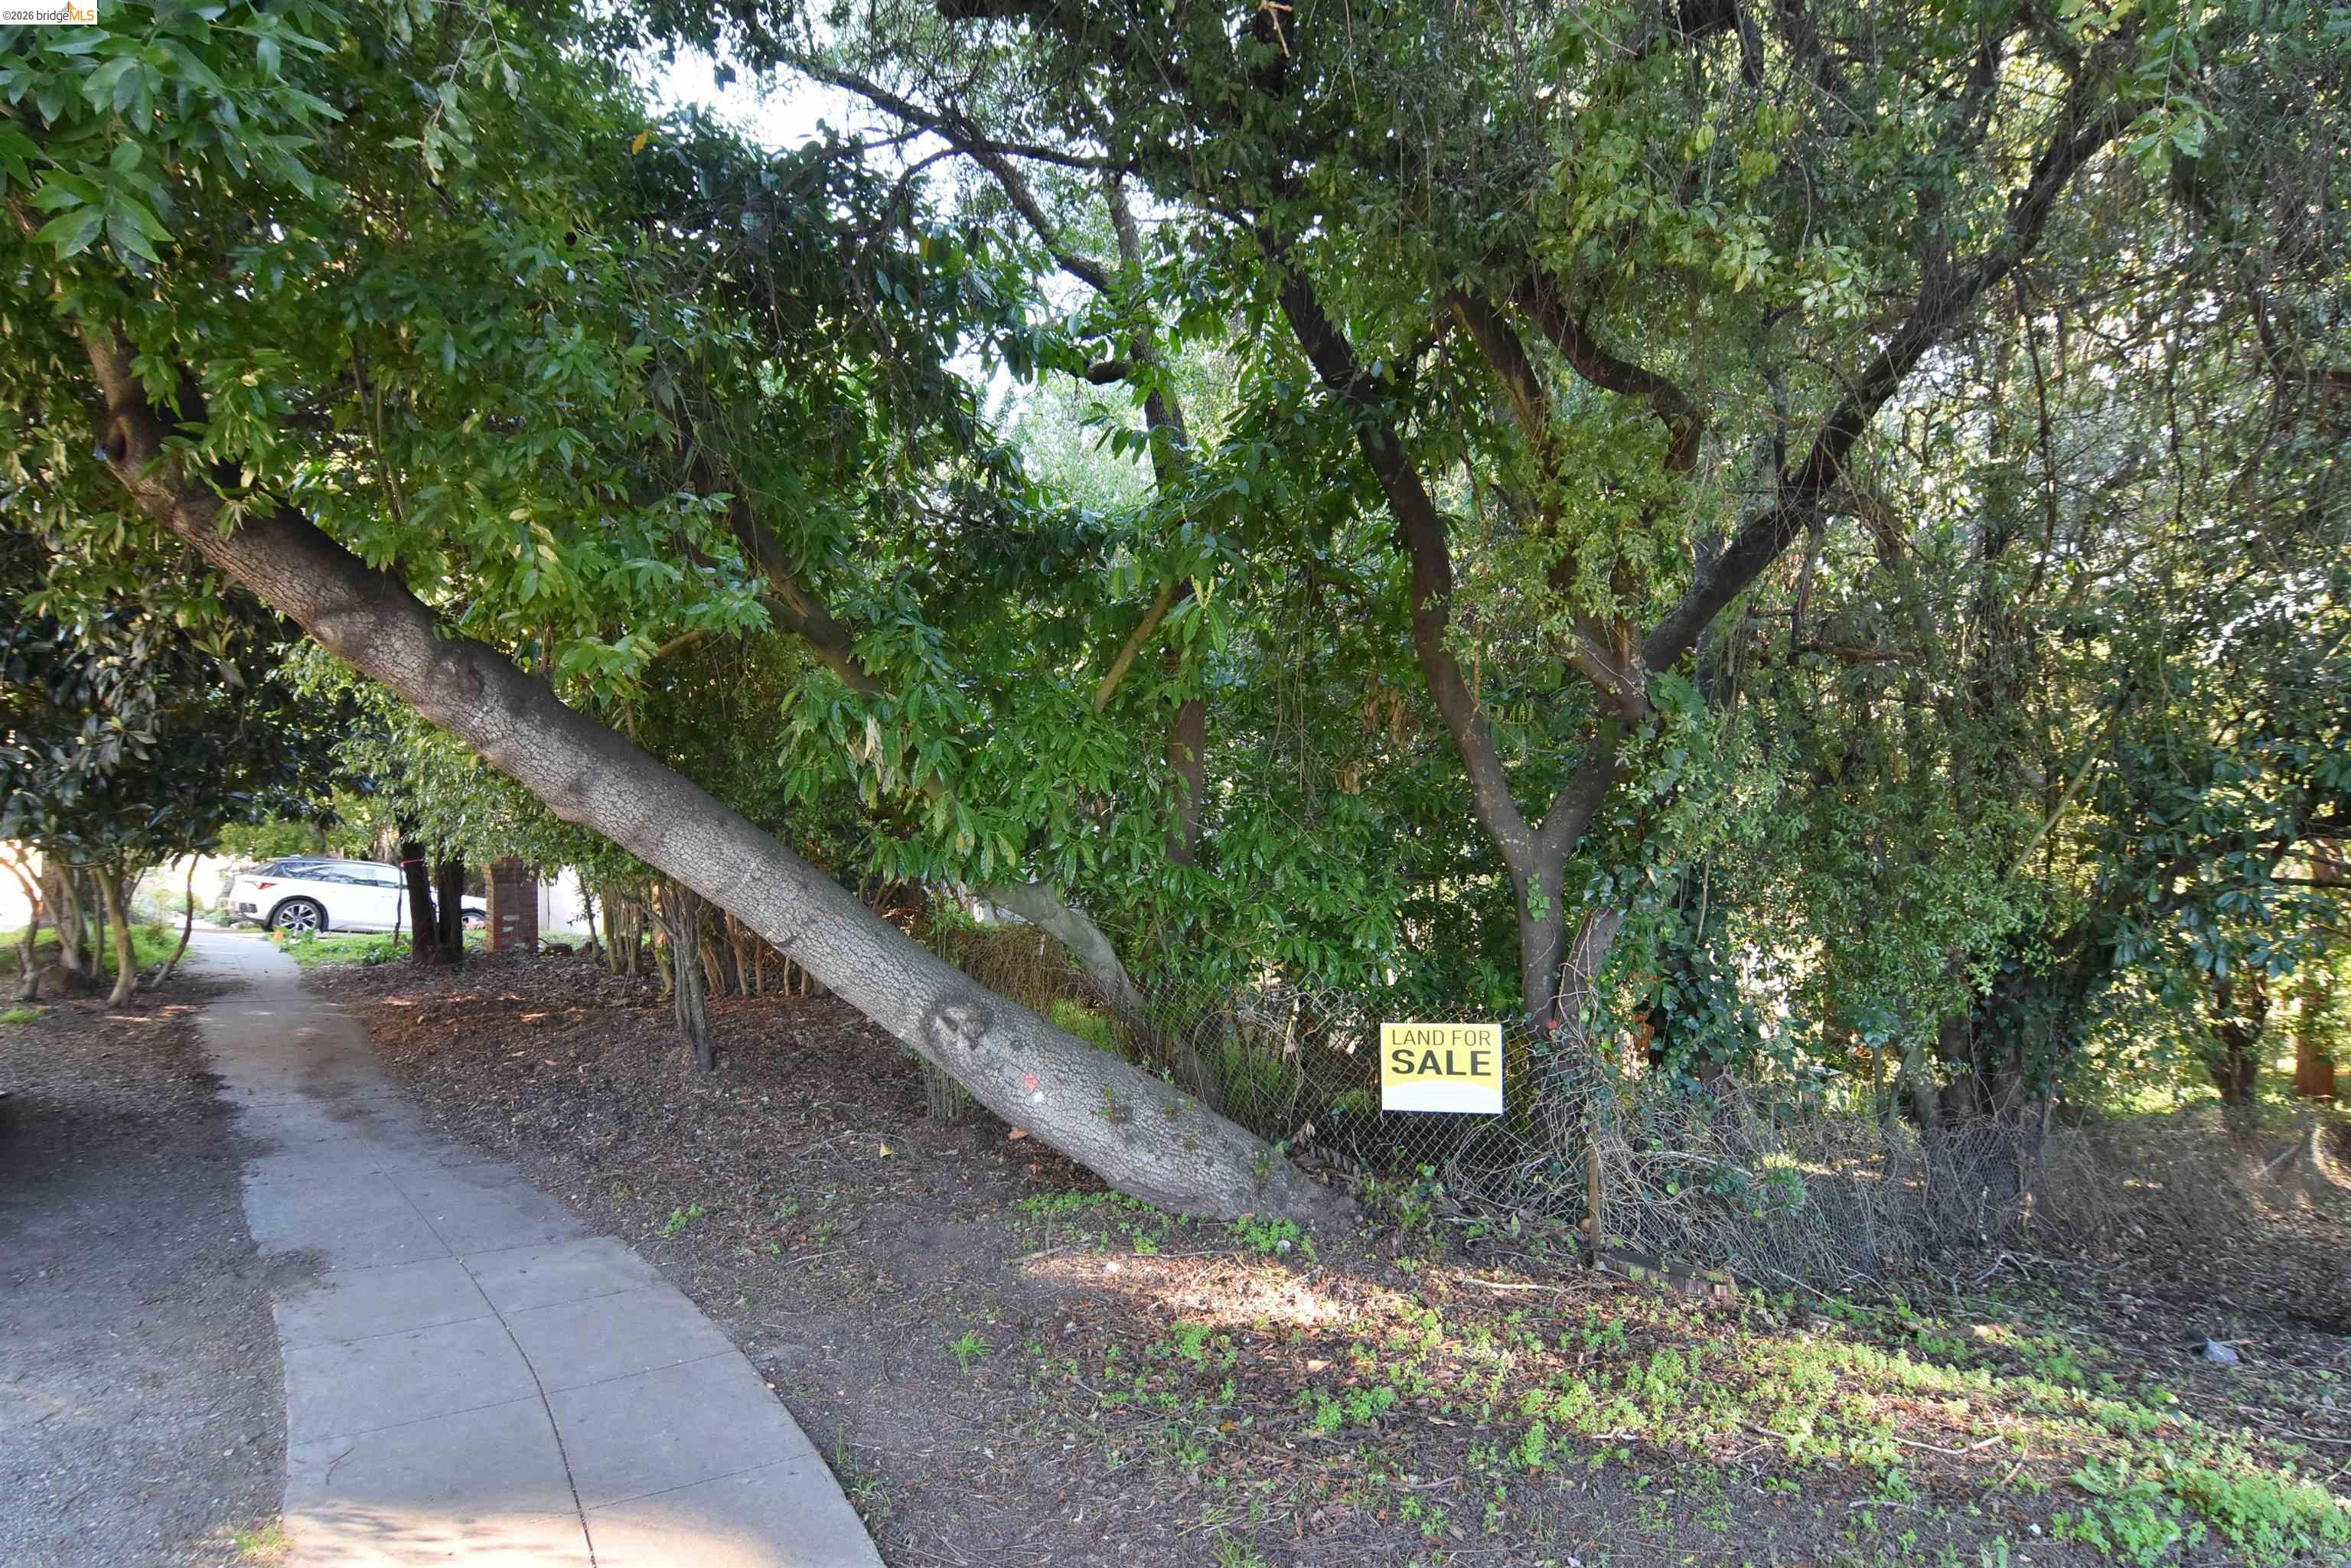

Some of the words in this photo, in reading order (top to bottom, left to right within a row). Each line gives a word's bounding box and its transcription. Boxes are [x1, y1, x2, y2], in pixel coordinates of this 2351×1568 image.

[1392, 1029, 1445, 1046] LAND
[1452, 1030, 1492, 1047] FOR
[1391, 1049, 1492, 1076] SALE
